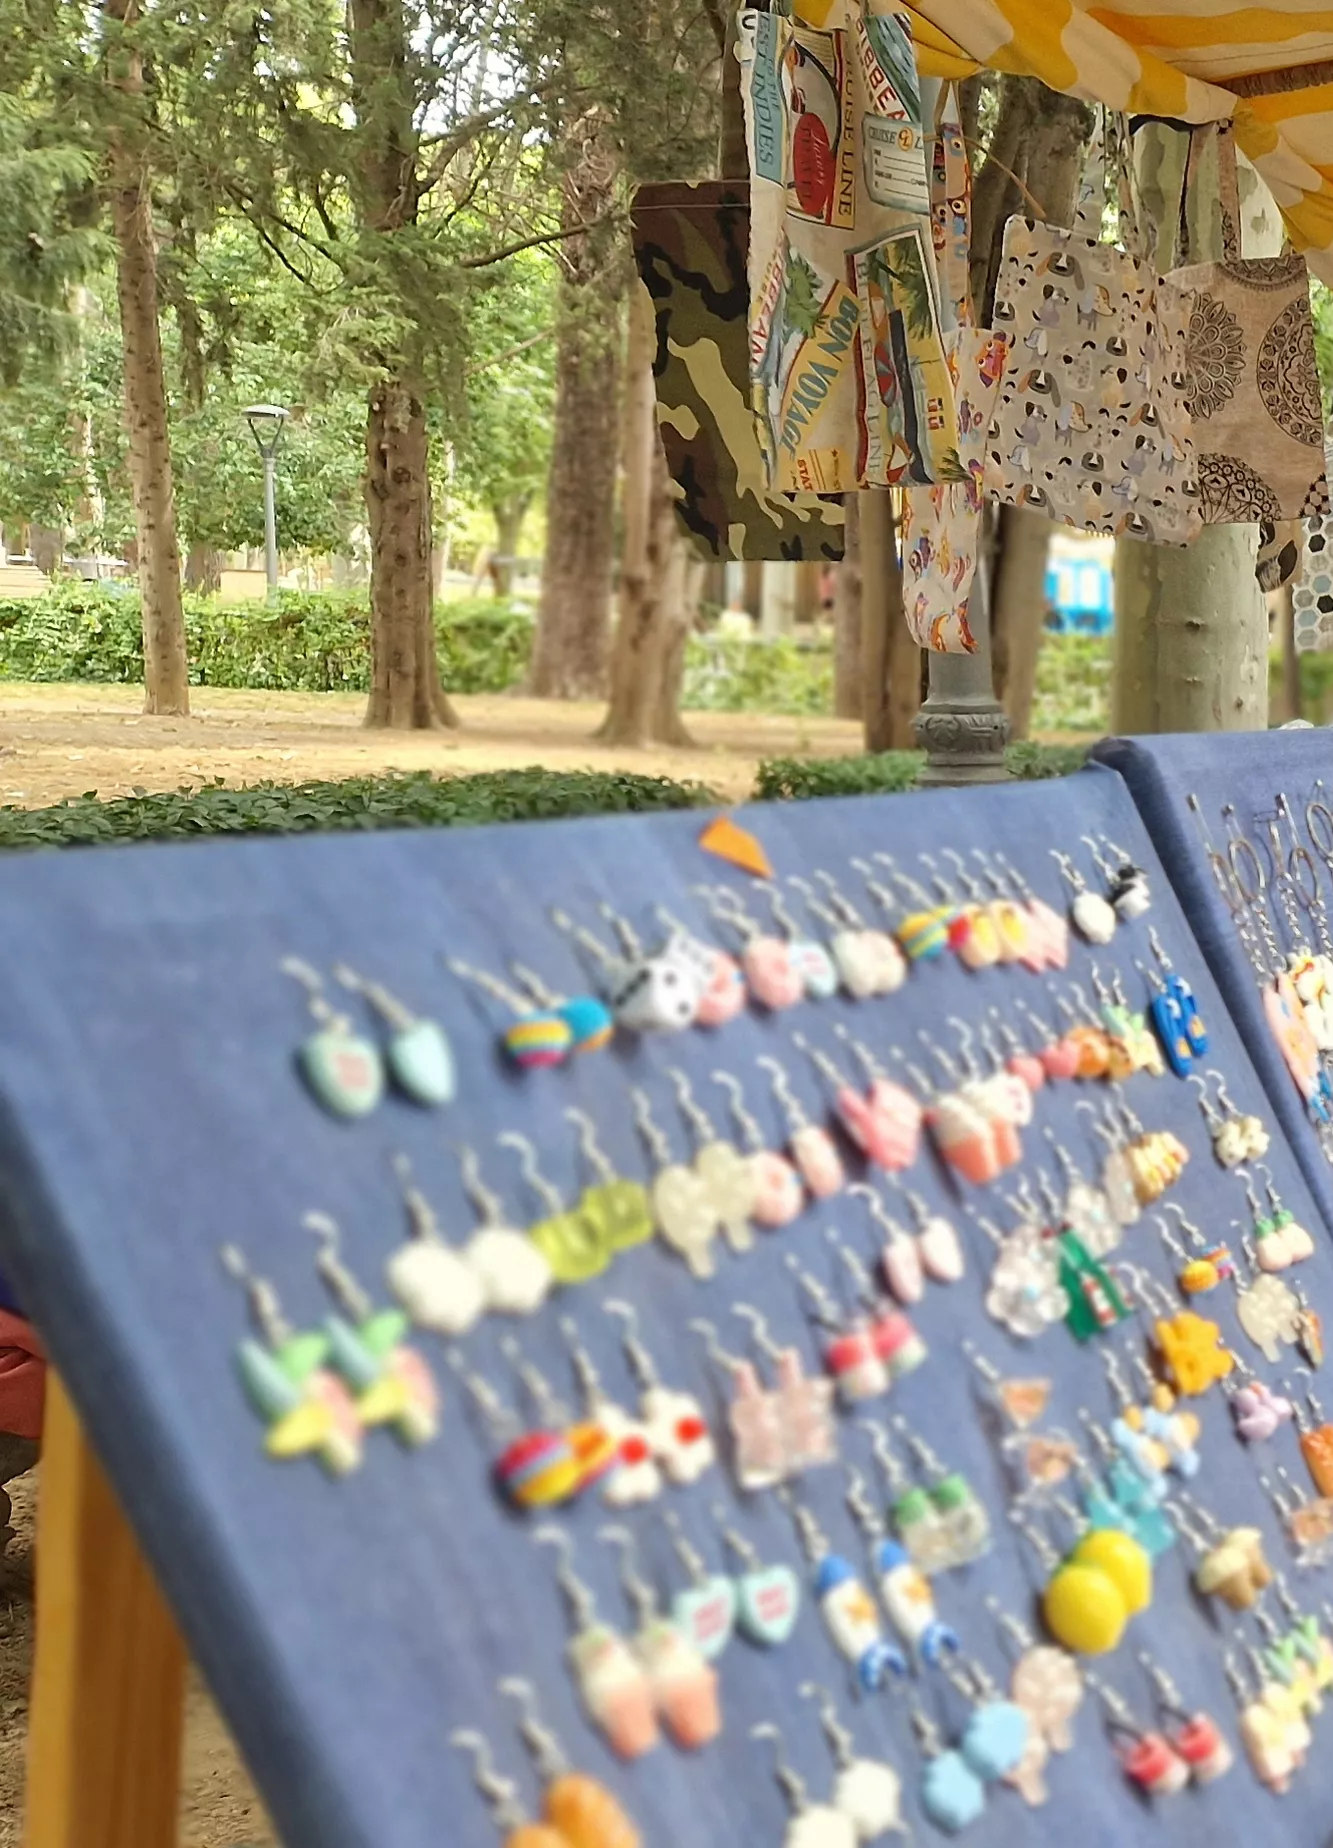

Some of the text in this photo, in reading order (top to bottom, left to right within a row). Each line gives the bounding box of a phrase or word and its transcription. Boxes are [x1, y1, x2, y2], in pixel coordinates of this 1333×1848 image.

[839, 150, 855, 216] LINE
[779, 295, 860, 460] BON VOYAGE
